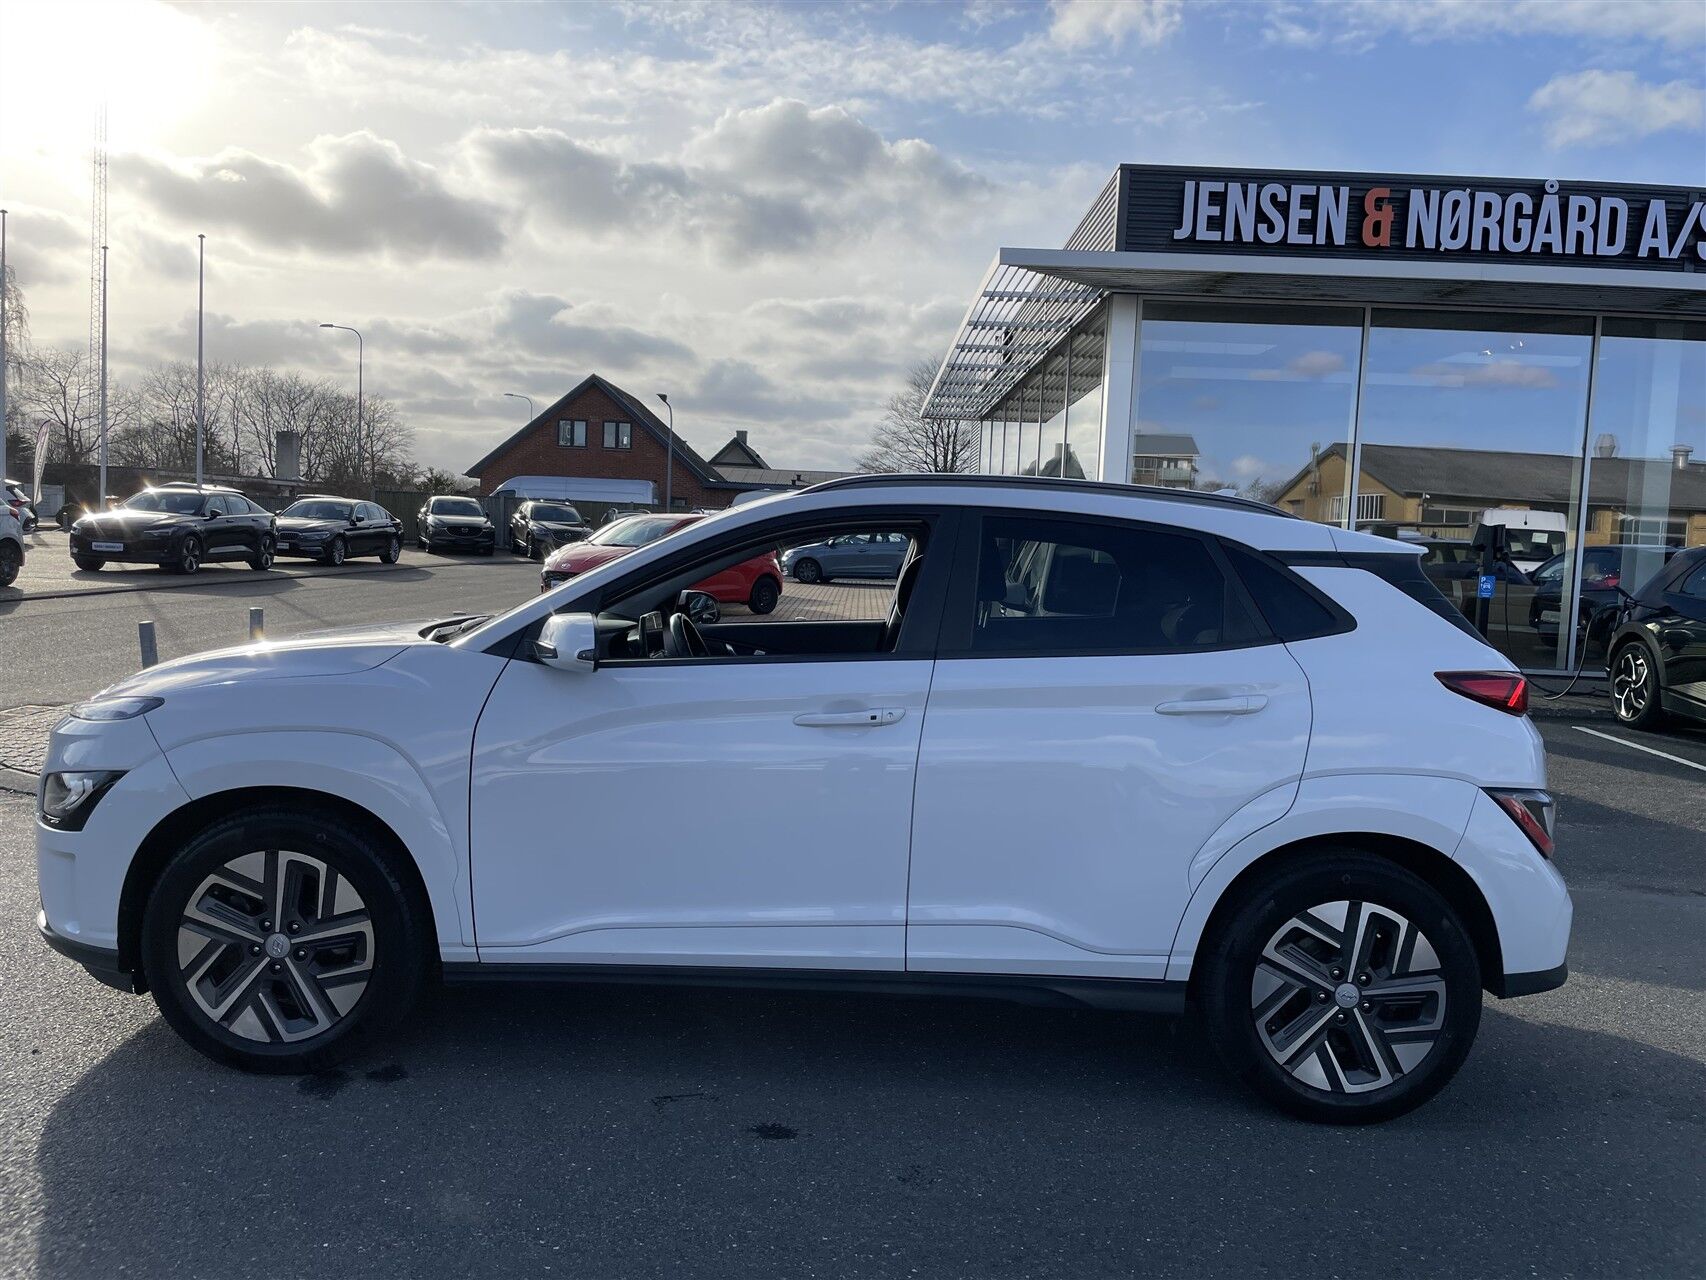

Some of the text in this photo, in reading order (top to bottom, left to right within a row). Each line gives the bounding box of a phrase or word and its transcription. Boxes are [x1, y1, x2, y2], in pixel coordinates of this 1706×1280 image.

[1173, 180, 1349, 246] JENSEN
[1361, 187, 1394, 248] &
[1406, 179, 1629, 258] NØRGÅRD
